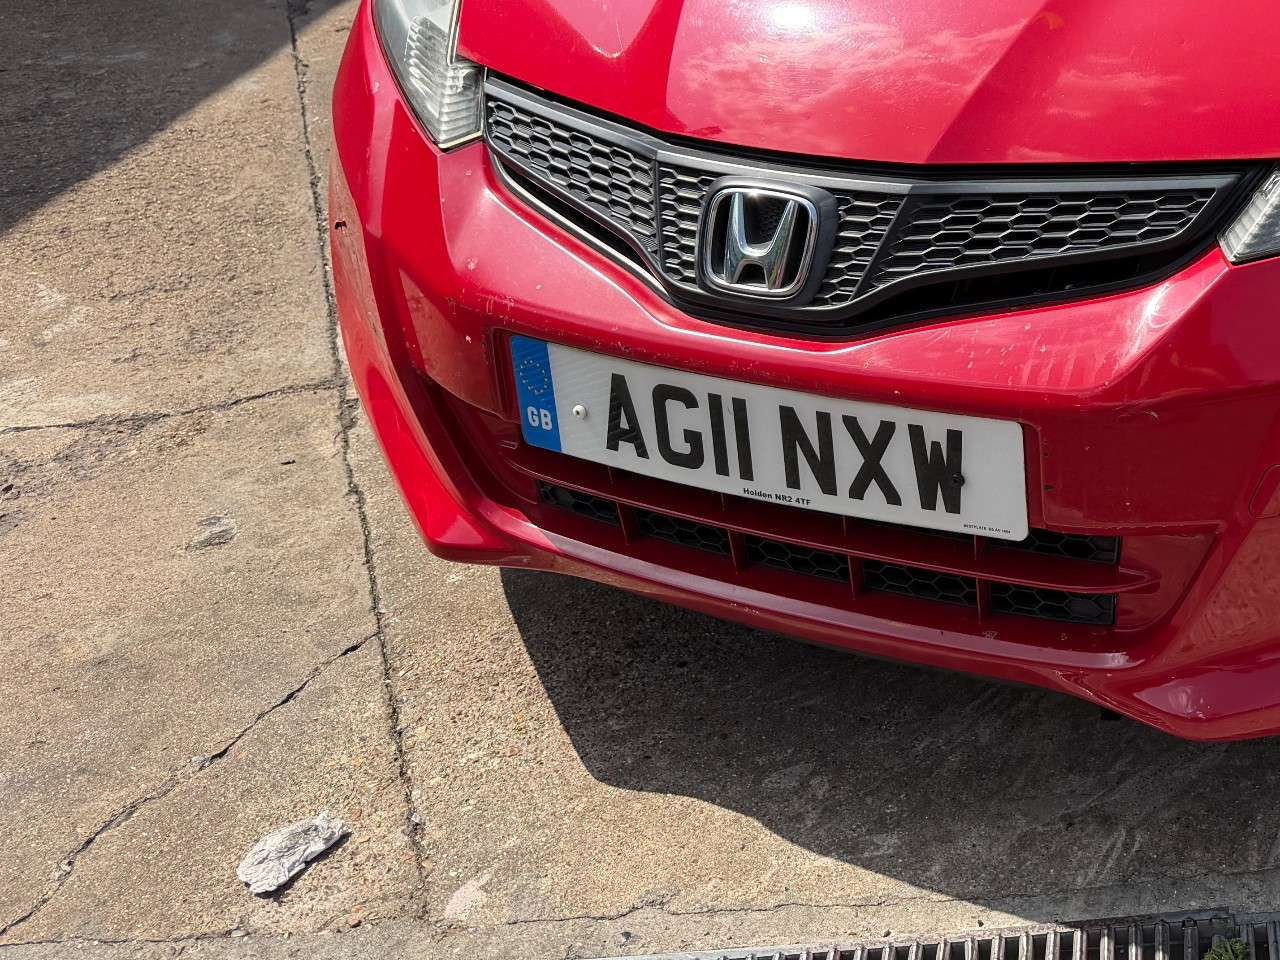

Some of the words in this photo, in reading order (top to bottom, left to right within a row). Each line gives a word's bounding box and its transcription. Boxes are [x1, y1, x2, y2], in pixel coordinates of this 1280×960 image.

[527, 406, 553, 431] GB
[606, 372, 755, 482] AG11
[779, 404, 966, 515] NXW
[743, 487, 773, 500] Holden
[775, 494, 792, 503] NR2
